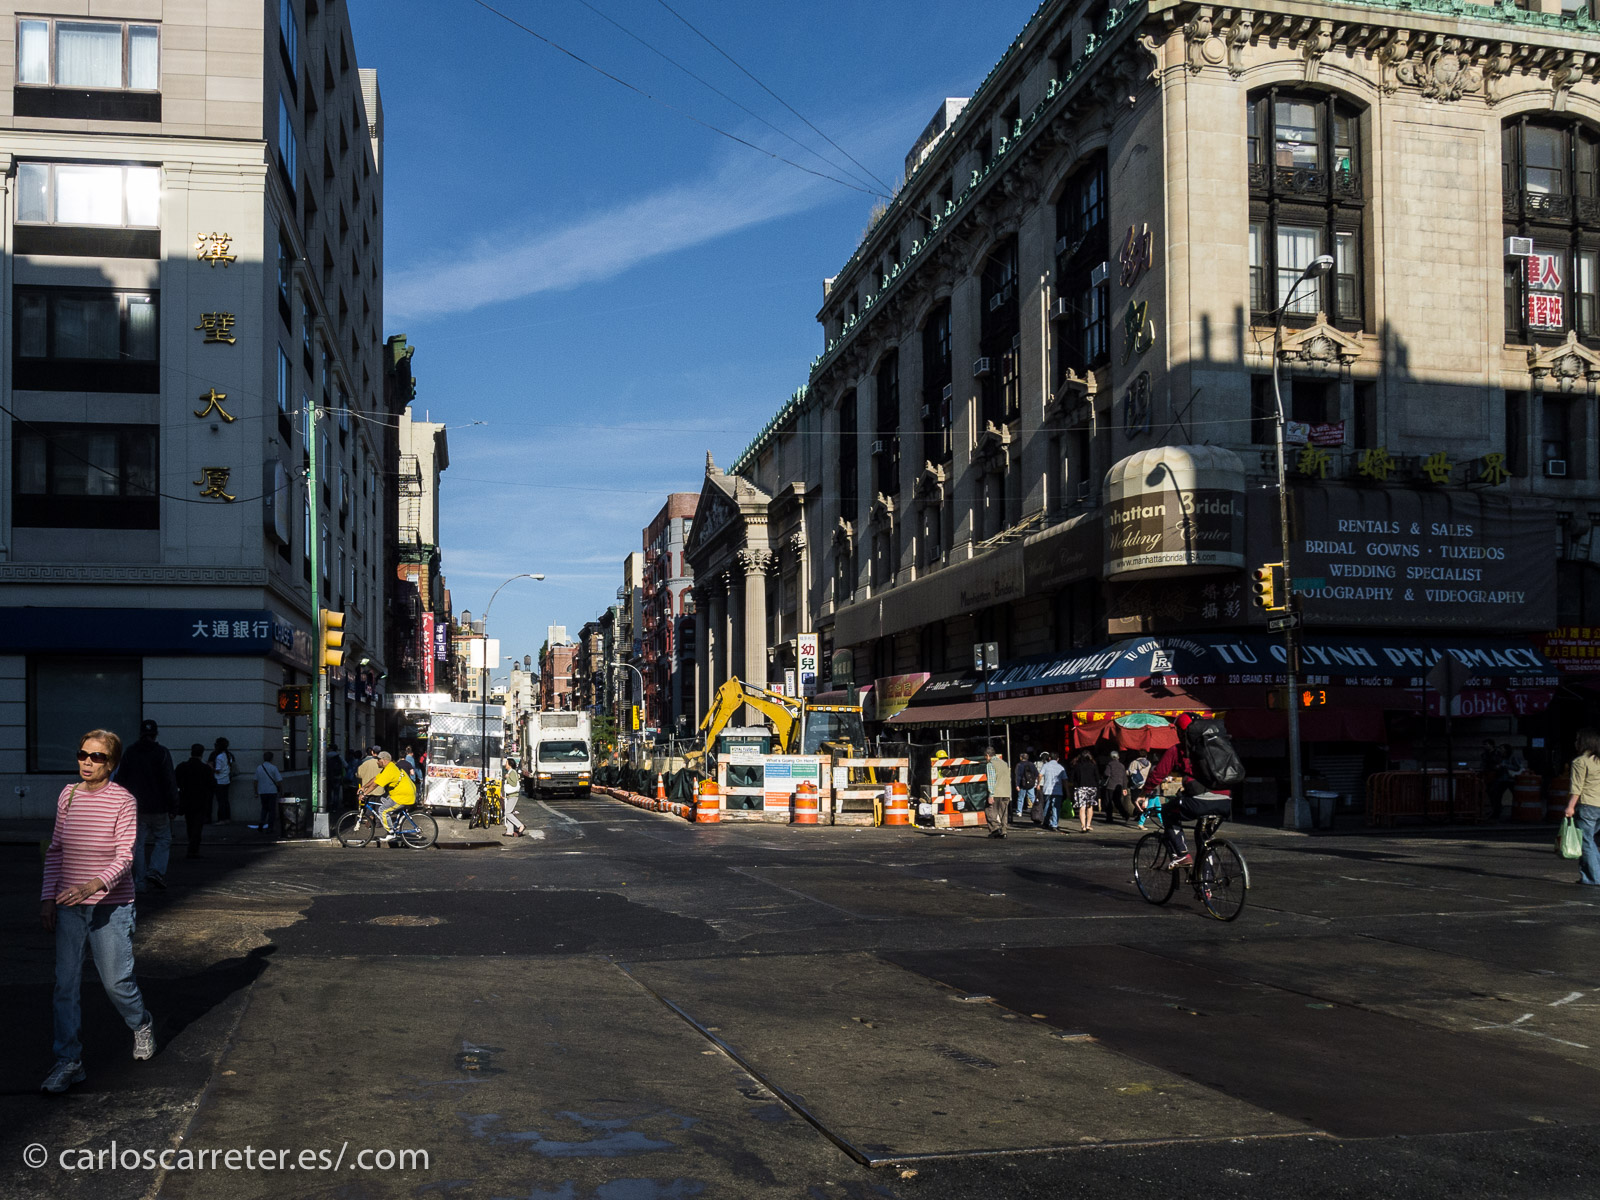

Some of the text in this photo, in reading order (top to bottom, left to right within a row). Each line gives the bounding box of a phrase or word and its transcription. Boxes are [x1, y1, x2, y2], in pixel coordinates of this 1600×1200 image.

[1178, 491, 1234, 516] Bridal
[1338, 519, 1474, 537] RENTALS & SALES
[1109, 524, 1163, 553] Wedding
[1305, 540, 1506, 560] BRIDAL GOWNS TUXEDOS
[1329, 564, 1483, 582] WEDDING SPECIALIST
[1404, 588, 1415, 602] &
[1425, 589, 1526, 604] VIDEOGRAPHY
[191, 620, 269, 639] 大通銀行
[1241, 674, 1263, 684] GRAND
[1319, 690, 1327, 705] 3
